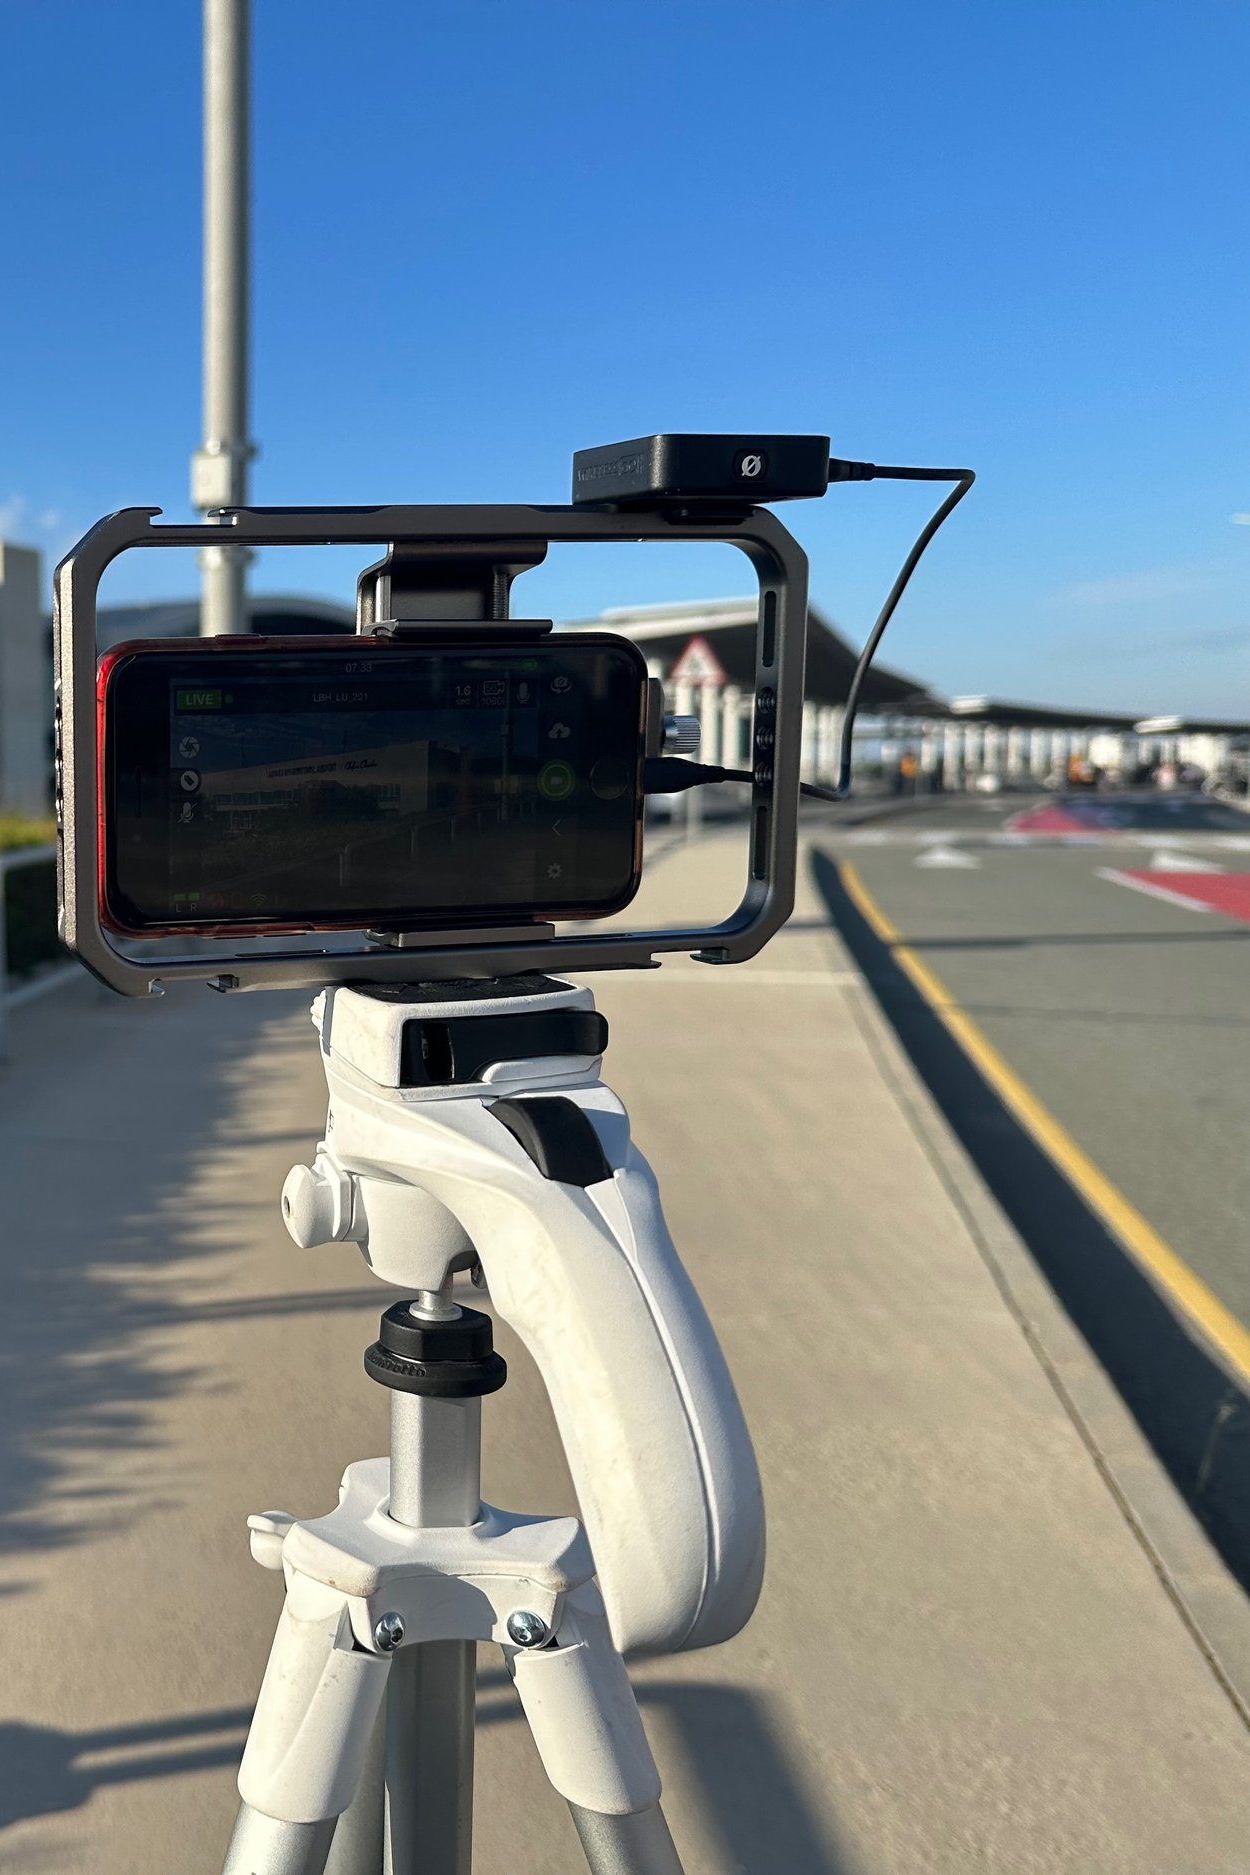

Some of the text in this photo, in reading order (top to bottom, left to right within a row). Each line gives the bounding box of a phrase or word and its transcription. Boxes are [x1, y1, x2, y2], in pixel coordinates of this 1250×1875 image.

[455, 685, 471, 697] 1.6
[186, 694, 213, 706] LIVE
[176, 903, 198, 913] L R
